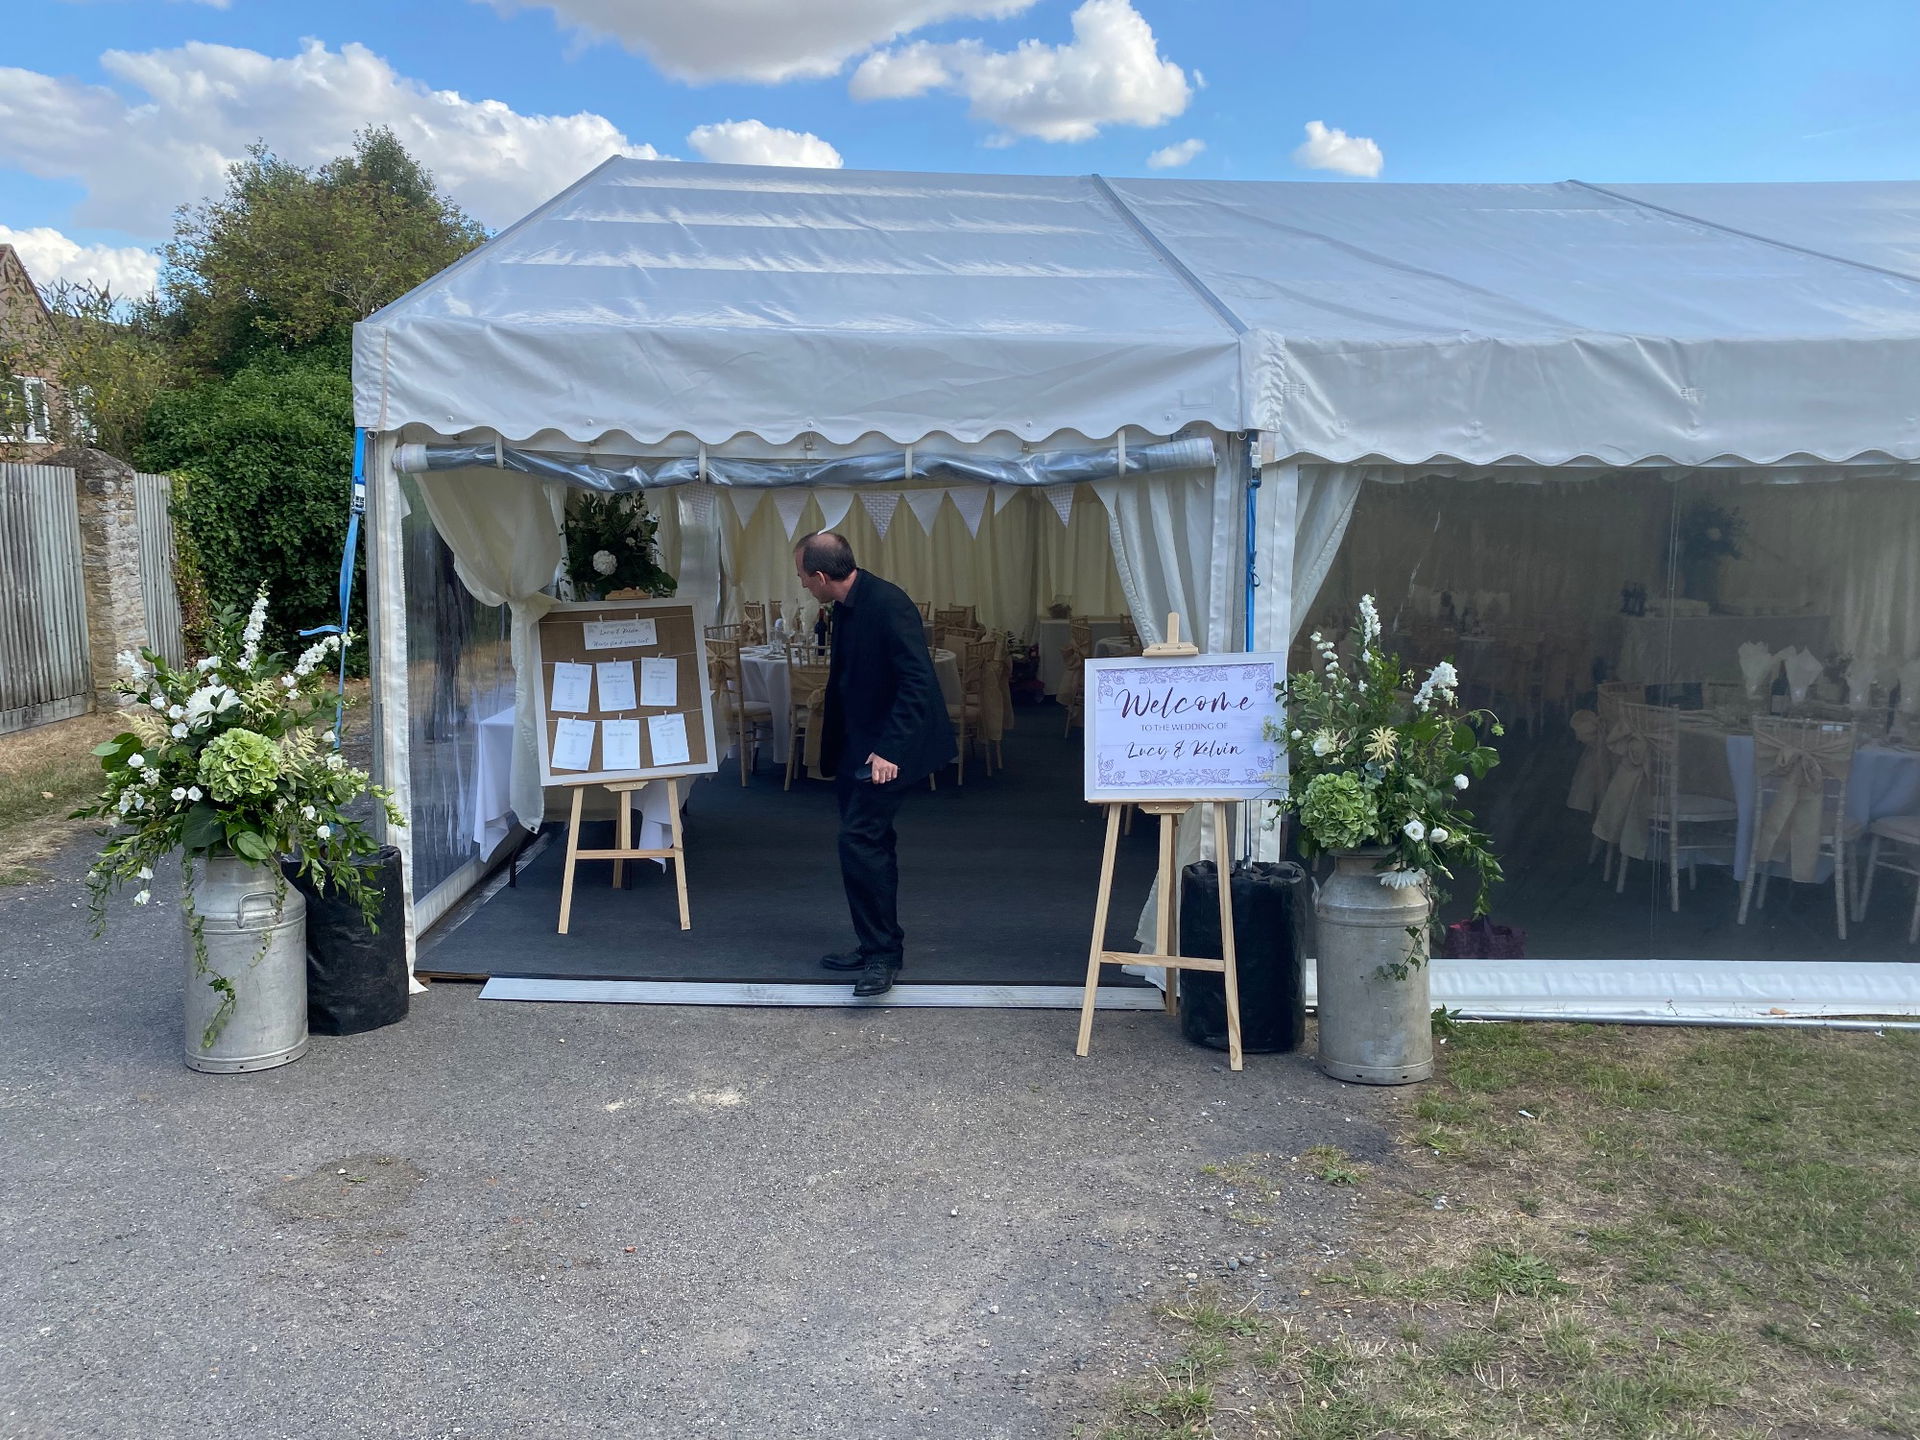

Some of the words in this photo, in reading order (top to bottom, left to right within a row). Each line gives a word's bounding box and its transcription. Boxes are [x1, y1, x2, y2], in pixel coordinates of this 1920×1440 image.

[1114, 687, 1255, 718] Welcome
[1172, 723, 1214, 731] WEDDING
[1125, 741, 1168, 760] Lucy
[1173, 740, 1185, 760] &
[1191, 740, 1246, 756] Kelvin
